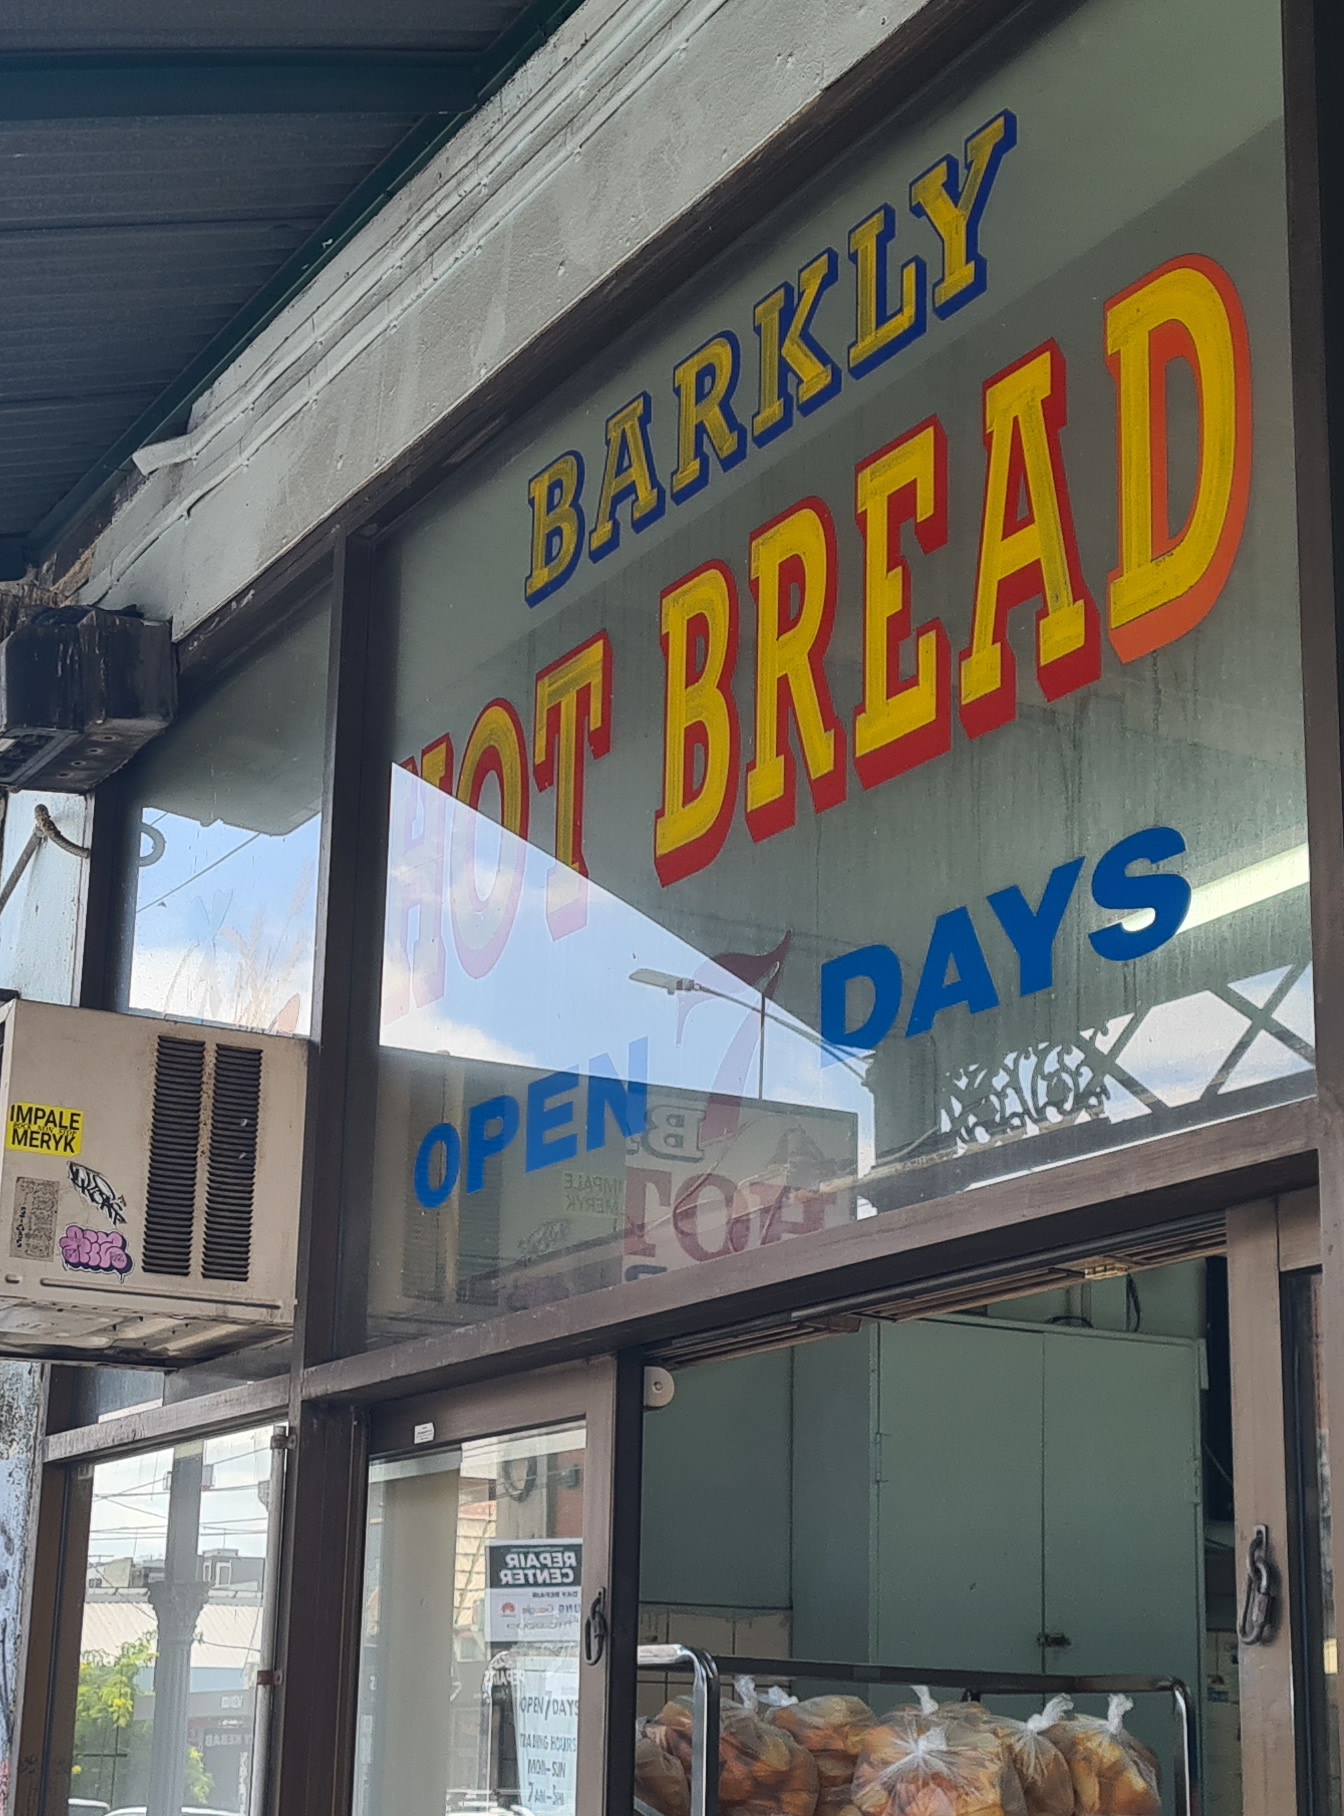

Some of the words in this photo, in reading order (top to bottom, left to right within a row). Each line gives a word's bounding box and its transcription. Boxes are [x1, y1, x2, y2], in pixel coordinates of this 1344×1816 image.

[524, 108, 1017, 608] BARKLY
[382, 628, 613, 1024] HOT
[654, 252, 1253, 888] BREAD
[9, 1104, 82, 1131] IMPALE
[413, 1036, 649, 1210] OPEN
[674, 930, 794, 1146] 7
[819, 825, 1193, 1069] DAYS
[11, 1128, 76, 1153] MERYK
[520, 1697, 544, 1714] OPEN
[544, 1690, 552, 1720] 7
